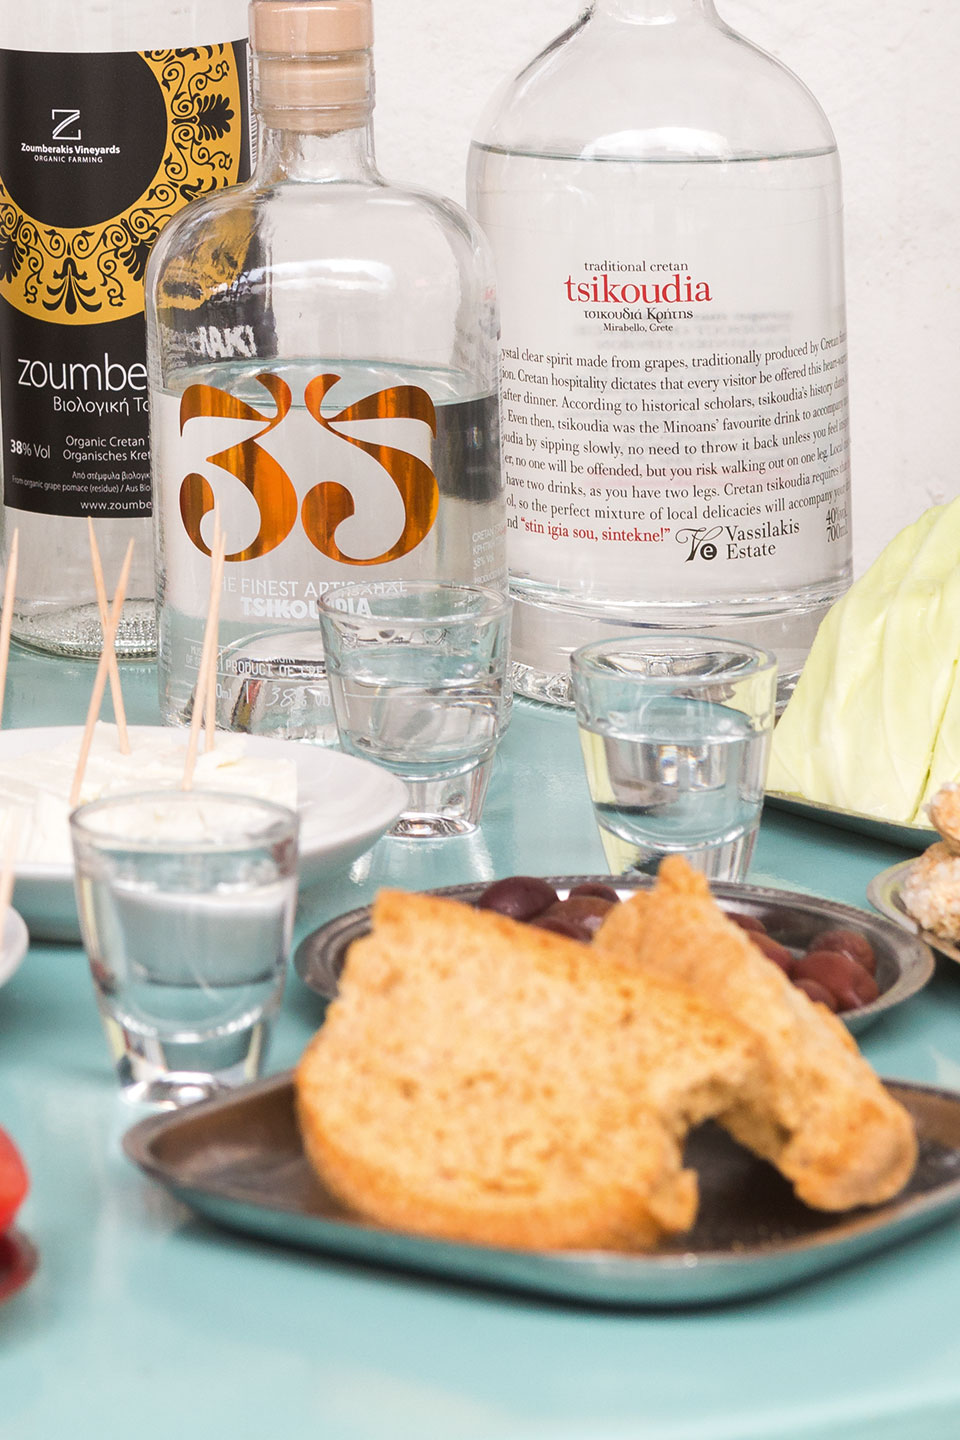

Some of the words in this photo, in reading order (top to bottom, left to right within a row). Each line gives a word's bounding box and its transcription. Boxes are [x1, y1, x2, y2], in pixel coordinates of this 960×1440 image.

[21, 142, 73, 154] Zoumberakis
[74, 144, 120, 155] Vineyards
[34, 155, 66, 163] ORGANIC
[68, 156, 103, 164] FARMING
[584, 260, 646, 272] traditional
[650, 262, 688, 272] cretan
[564, 274, 712, 303] tsikoudia
[603, 323, 647, 332] Mirabello,
[649, 324, 673, 332] Crete
[522, 349, 544, 363] clear
[546, 353, 573, 368] spirit
[576, 355, 608, 368] made
[611, 355, 640, 368] from
[645, 359, 688, 372] grapes,
[692, 350, 762, 367] traditionally
[765, 342, 808, 362] produced
[810, 341, 819, 356] by
[17, 352, 147, 391] zoumbe
[518, 369, 549, 385] Cretan
[551, 373, 607, 393] hospitality
[611, 377, 657, 390] dictates
[660, 377, 684, 390] that
[688, 379, 719, 392] every
[722, 374, 756, 387] visitor
[760, 371, 772, 384] be
[775, 364, 807, 381] offered
[808, 361, 821, 375] this
[53, 395, 130, 417] Βιολογική
[503, 388, 521, 402] after
[524, 391, 558, 407] dinner.
[561, 396, 622, 415] According
[625, 401, 638, 411] to
[642, 398, 699, 412] historical
[704, 395, 755, 410] scholars,
[508, 409, 528, 424] Even
[530, 413, 555, 429] then,
[558, 419, 609, 433] tsikoudia
[613, 424, 635, 433] was
[639, 421, 659, 433] the
[663, 419, 719, 433] Minoans’
[723, 415, 771, 431] favourite
[774, 409, 800, 425] drink
[802, 409, 811, 420] to
[10, 439, 32, 457] 38%
[33, 443, 51, 459] Vol
[66, 435, 107, 449] Organic
[109, 436, 145, 447] Cretan
[526, 434, 537, 451] by
[540, 438, 579, 455] sipping
[583, 441, 624, 458] slowly,
[628, 446, 644, 455] no
[648, 442, 679, 455] need
[684, 445, 697, 455] to
[701, 441, 738, 454] throw
[742, 438, 749, 451] it
[753, 435, 779, 450] back
[782, 429, 811, 446] unless
[813, 427, 827, 443] you
[63, 449, 128, 463] Organisches
[515, 456, 527, 467] no
[529, 460, 545, 471] one
[548, 460, 567, 472] will
[570, 462, 584, 474] be
[587, 463, 642, 477] offended,
[646, 464, 666, 477] but
[670, 468, 692, 480] you
[696, 462, 717, 476] risk
[721, 460, 765, 476] walking
[768, 458, 785, 469] out
[787, 456, 799, 466] on
[801, 453, 816, 464] one
[179, 373, 440, 566] 35
[506, 472, 525, 488] have
[527, 480, 544, 491] two
[547, 480, 587, 496] drinks,
[590, 488, 602, 497] as
[605, 488, 627, 501] you
[632, 486, 661, 498] have
[665, 488, 689, 498] two
[693, 485, 720, 501] legs.
[724, 482, 763, 496] Cretan
[766, 473, 811, 491] tsikoudia
[518, 499, 529, 509] so
[531, 498, 548, 513] the
[551, 502, 591, 518] perfect
[594, 506, 645, 520] mixture
[649, 507, 664, 520] of
[667, 505, 698, 520] local
[702, 504, 761, 520] delicacies
[764, 497, 785, 513] will
[547, 521, 569, 540] igia
[572, 528, 598, 542] sou,
[725, 519, 800, 541] Vassilakis
[726, 543, 776, 560] Estate
[241, 578, 299, 597] FINEST
